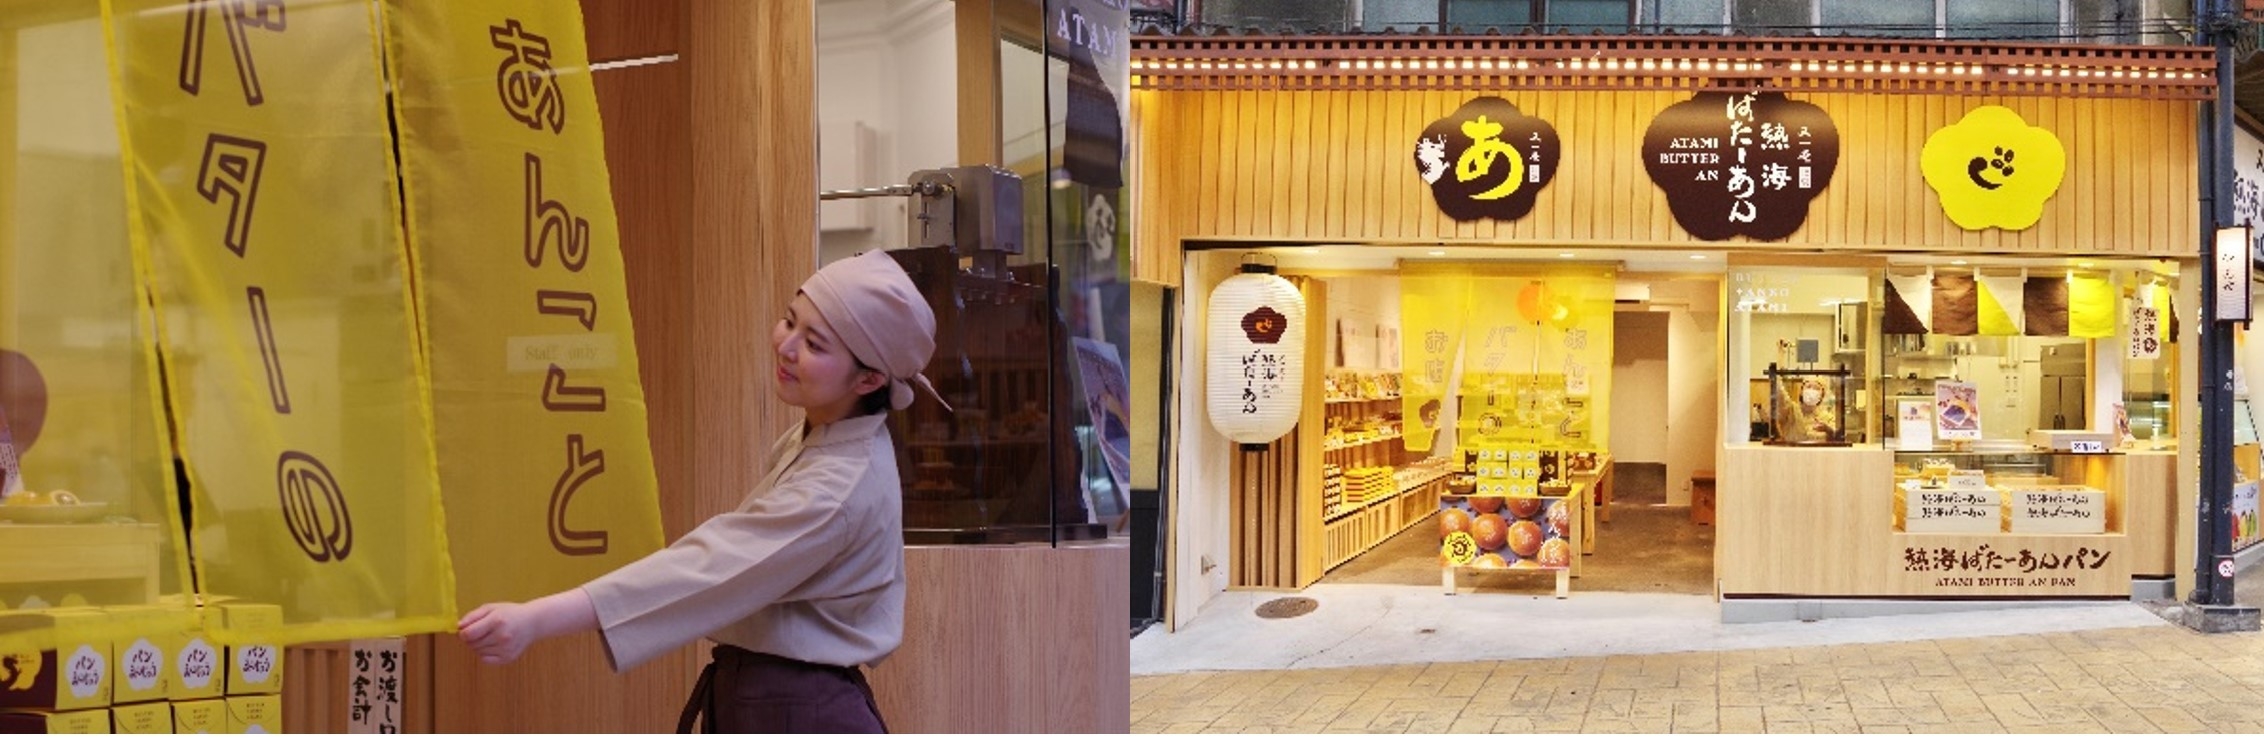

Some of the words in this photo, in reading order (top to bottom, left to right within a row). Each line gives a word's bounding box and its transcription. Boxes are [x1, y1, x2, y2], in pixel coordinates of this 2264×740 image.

[1456, 115, 1525, 199] あ
[1659, 153, 1720, 164] BUTTER
[1670, 138, 1719, 149] ATAMI
[1726, 85, 1761, 223] ばたーあん
[1760, 122, 1792, 190] 熱海
[1694, 170, 1719, 181] AN
[489, 19, 608, 556] あんこと
[1904, 543, 2111, 574] 熱海ばたーあんパン
[1935, 577, 1973, 587] ATAMI
[1978, 577, 2024, 587] BUTTER
[2028, 577, 2047, 587] AN
[2051, 577, 2076, 587] PAN
[353, 648, 373, 725] お会計
